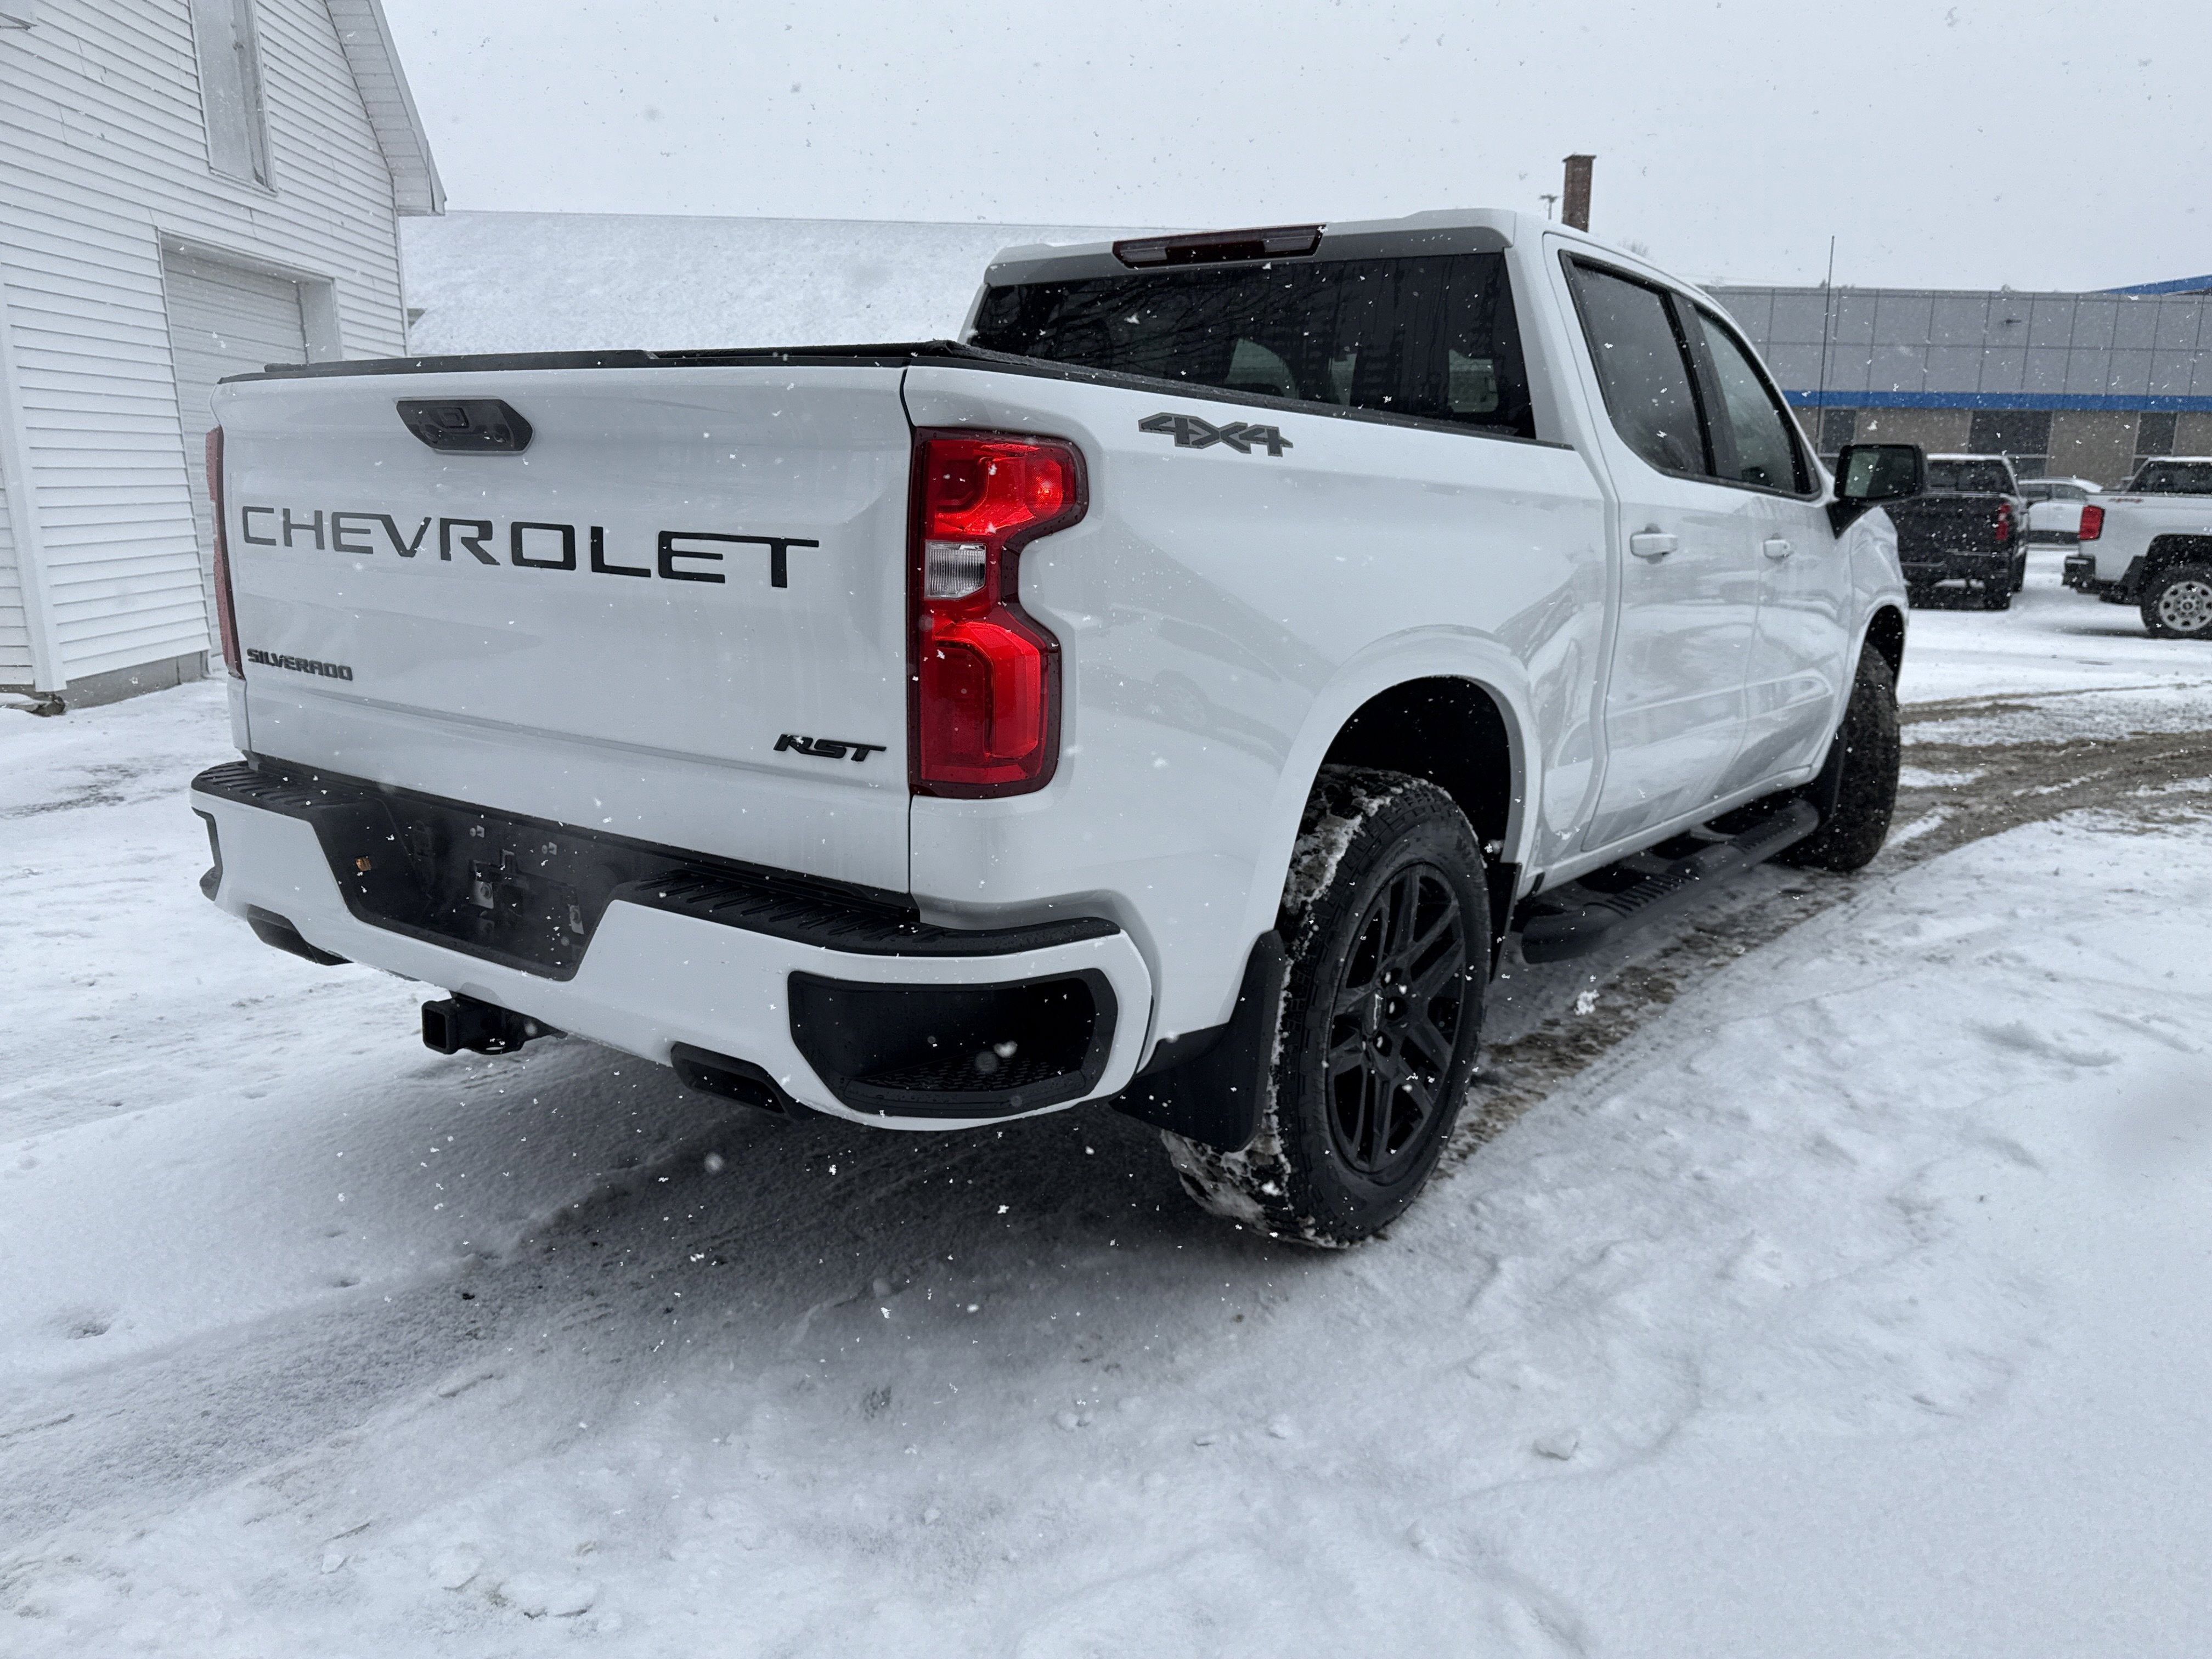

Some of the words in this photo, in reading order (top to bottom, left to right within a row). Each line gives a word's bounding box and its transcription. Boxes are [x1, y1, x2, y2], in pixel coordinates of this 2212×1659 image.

[242, 506, 819, 588] CHEVROLET
[247, 648, 353, 681] SILVERADO
[773, 733, 887, 762] RST
